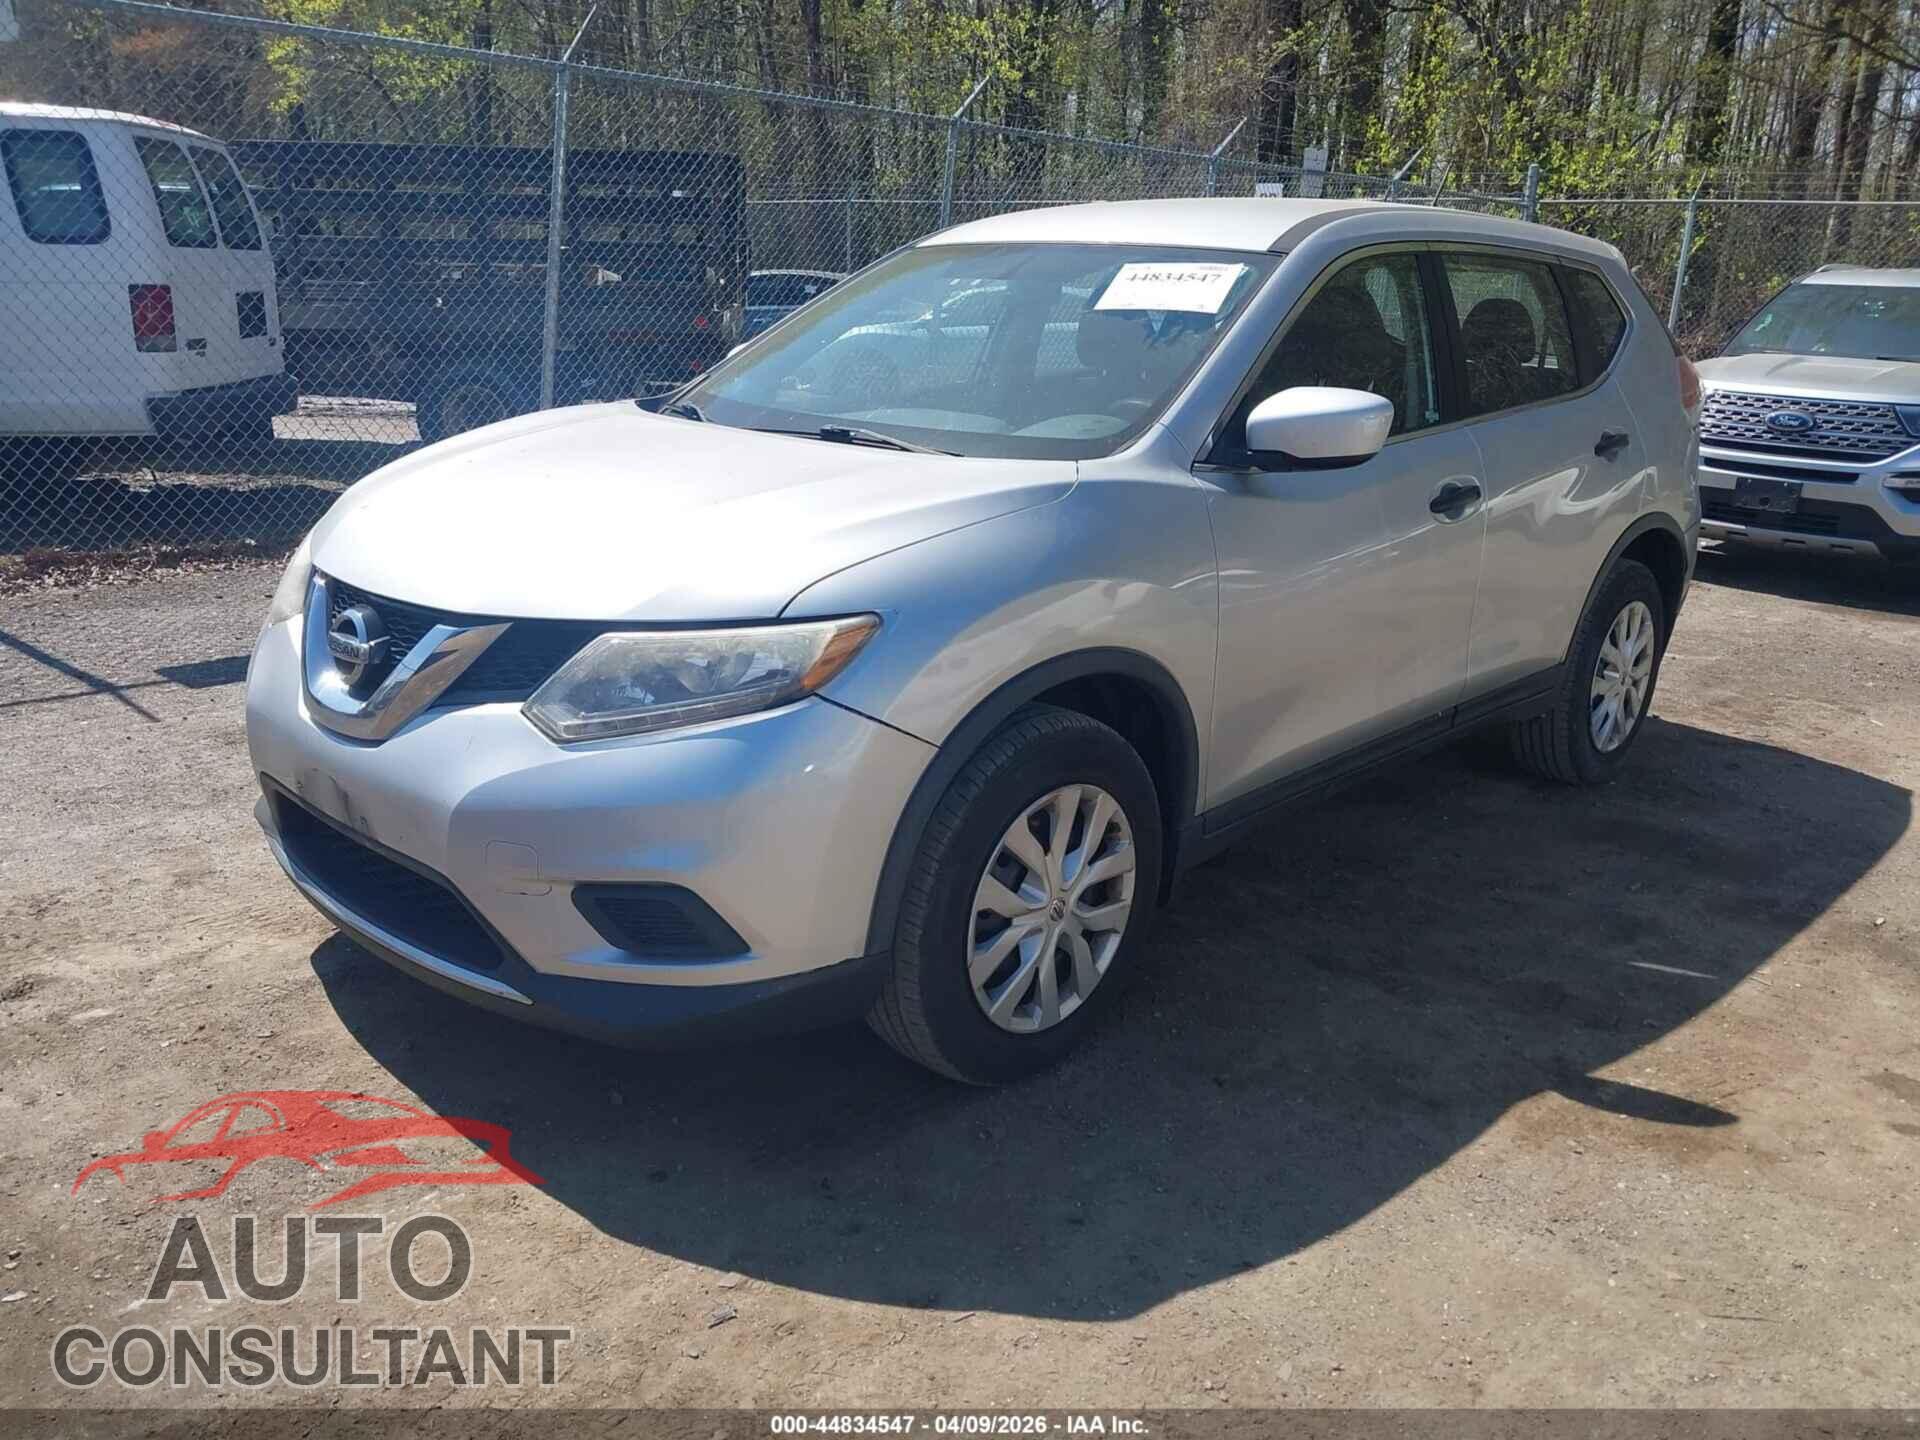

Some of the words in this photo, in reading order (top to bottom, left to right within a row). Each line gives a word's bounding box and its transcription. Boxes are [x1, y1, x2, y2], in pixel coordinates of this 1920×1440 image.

[1126, 272, 1222, 283] 44834547
[1775, 414, 1802, 427] Ford
[328, 637, 360, 658] SSAN
